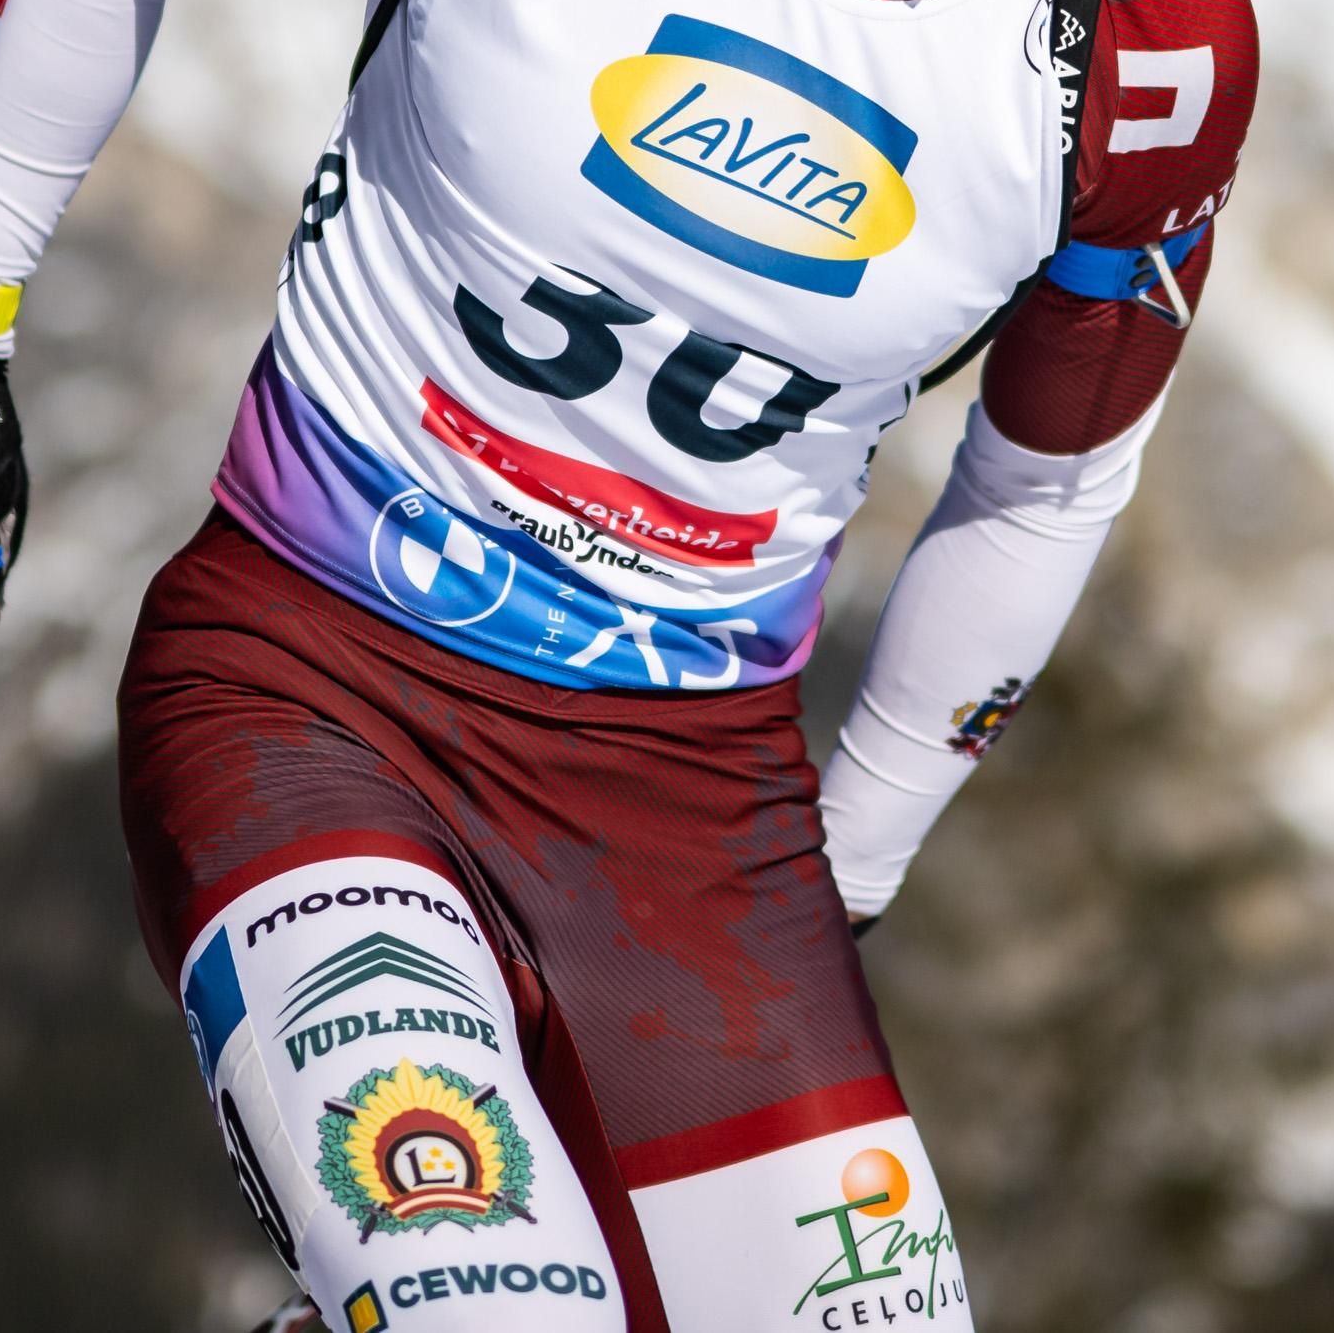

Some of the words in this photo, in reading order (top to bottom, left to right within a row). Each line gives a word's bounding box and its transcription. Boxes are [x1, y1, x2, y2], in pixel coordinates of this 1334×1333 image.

[453, 261, 841, 463] 30
[285, 1008, 502, 1073] VUDLANDE
[390, 1263, 607, 1308] CEWOOD
[822, 1278, 965, 1331] CEĻOJU
